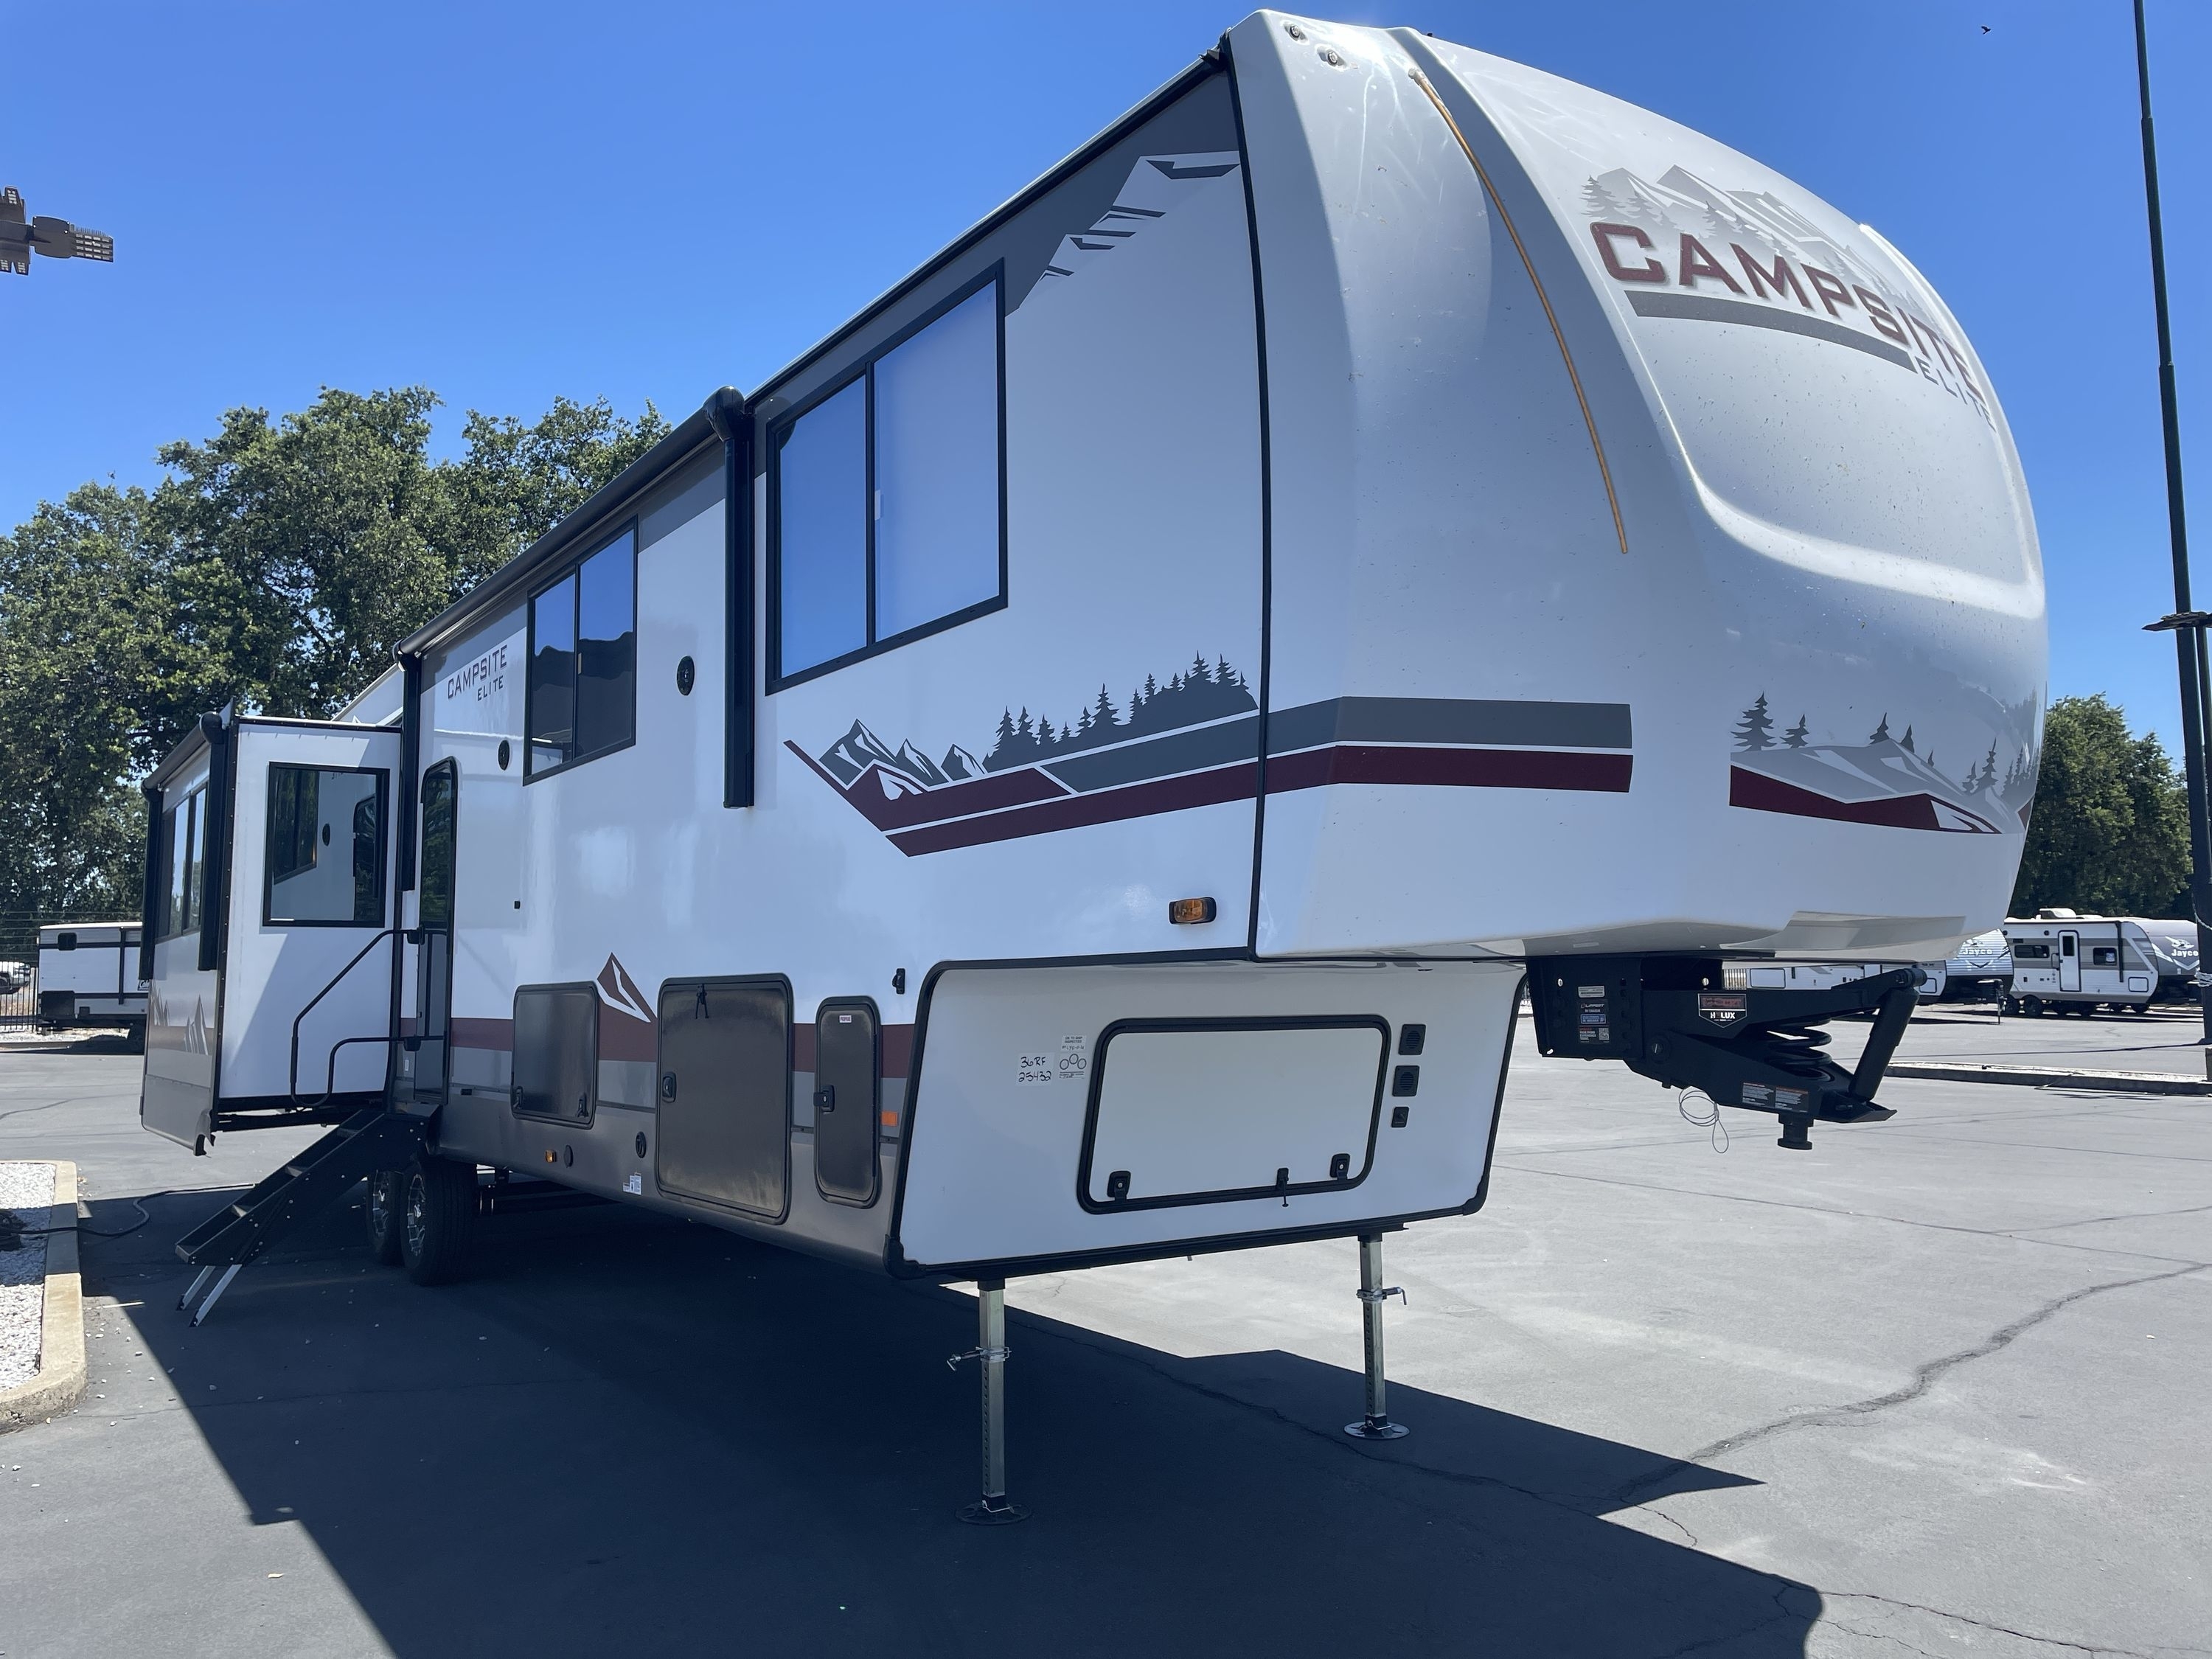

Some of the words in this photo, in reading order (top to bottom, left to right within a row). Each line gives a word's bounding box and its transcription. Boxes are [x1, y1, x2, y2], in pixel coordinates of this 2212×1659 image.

[1590, 221, 1986, 406] CAMPSITE
[1915, 356, 1997, 433] ELITE
[448, 644, 507, 700] CAMPSITE
[477, 675, 504, 701] ELITE
[1962, 947, 1993, 957] Jayco
[2171, 949, 2199, 958] Jayco
[1018, 1071, 1052, 1082] 25432
